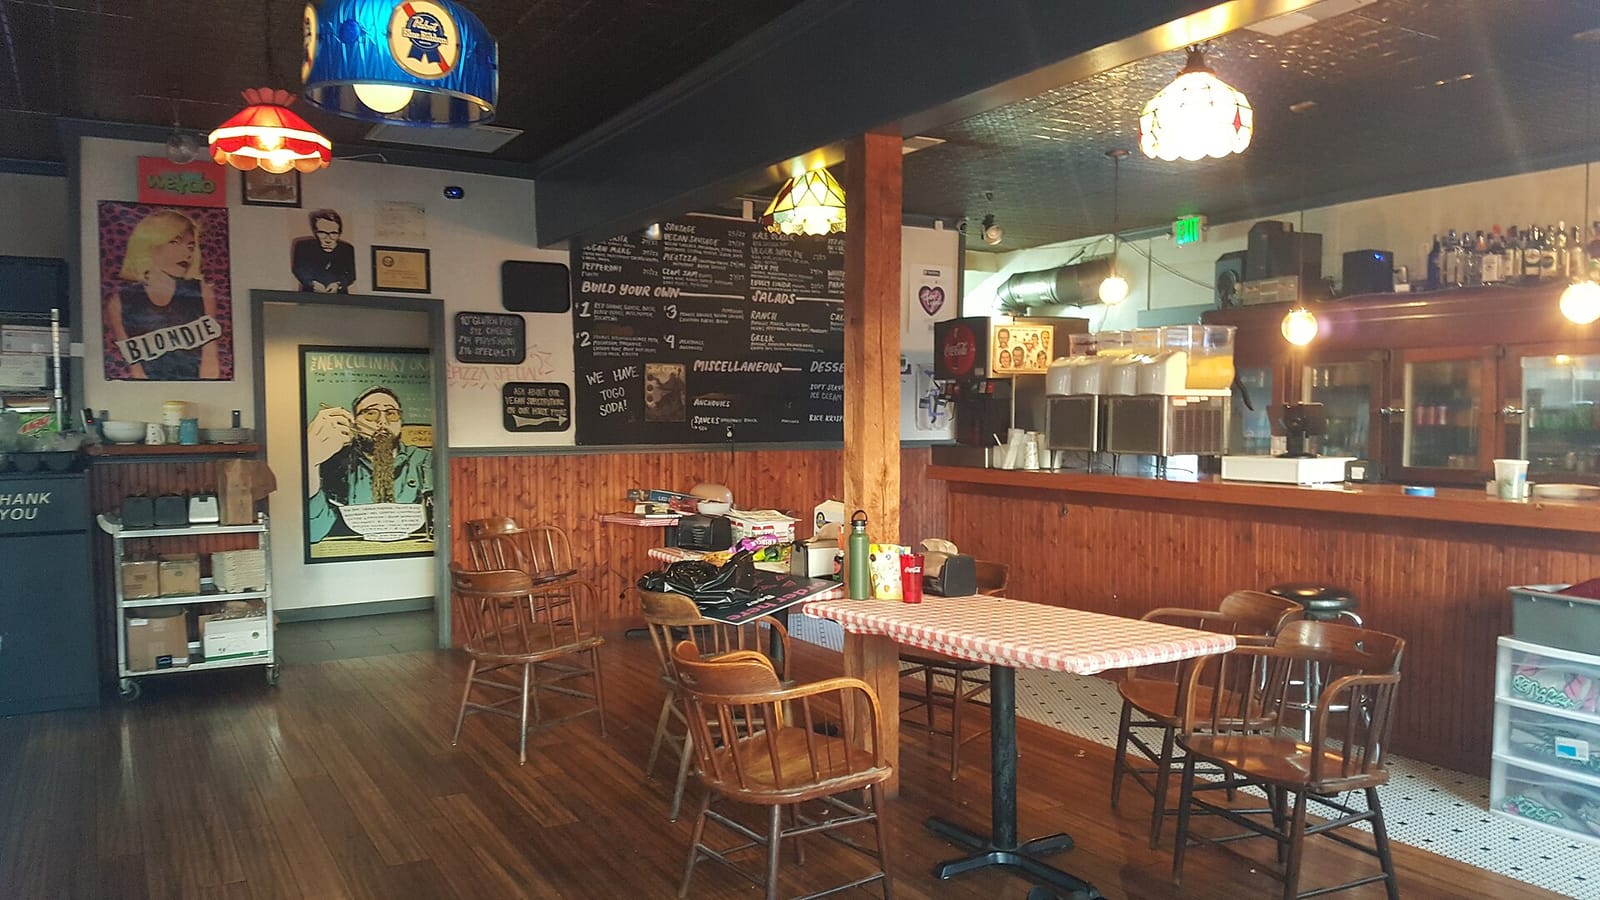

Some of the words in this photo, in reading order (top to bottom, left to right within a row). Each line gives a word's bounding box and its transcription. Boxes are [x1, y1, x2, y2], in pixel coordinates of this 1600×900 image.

[1177, 217, 1199, 244] EXIT
[581, 280, 617, 294] BUILD
[618, 283, 652, 297] YOUR
[653, 286, 681, 299] OWN
[751, 290, 796, 305] SALADS
[750, 310, 778, 321] RANCH
[126, 318, 216, 362] BLONDIE
[750, 333, 775, 343] GREEK
[317, 354, 343, 372] NEW
[693, 359, 783, 374] MISCELLANEOUS
[586, 371, 605, 386] WE
[612, 365, 640, 382] HAVE
[600, 386, 625, 401] TOGO
[599, 399, 628, 417] SODA!
[693, 398, 731, 408] ANCHOVIES
[0, 508, 38, 520] YOU
